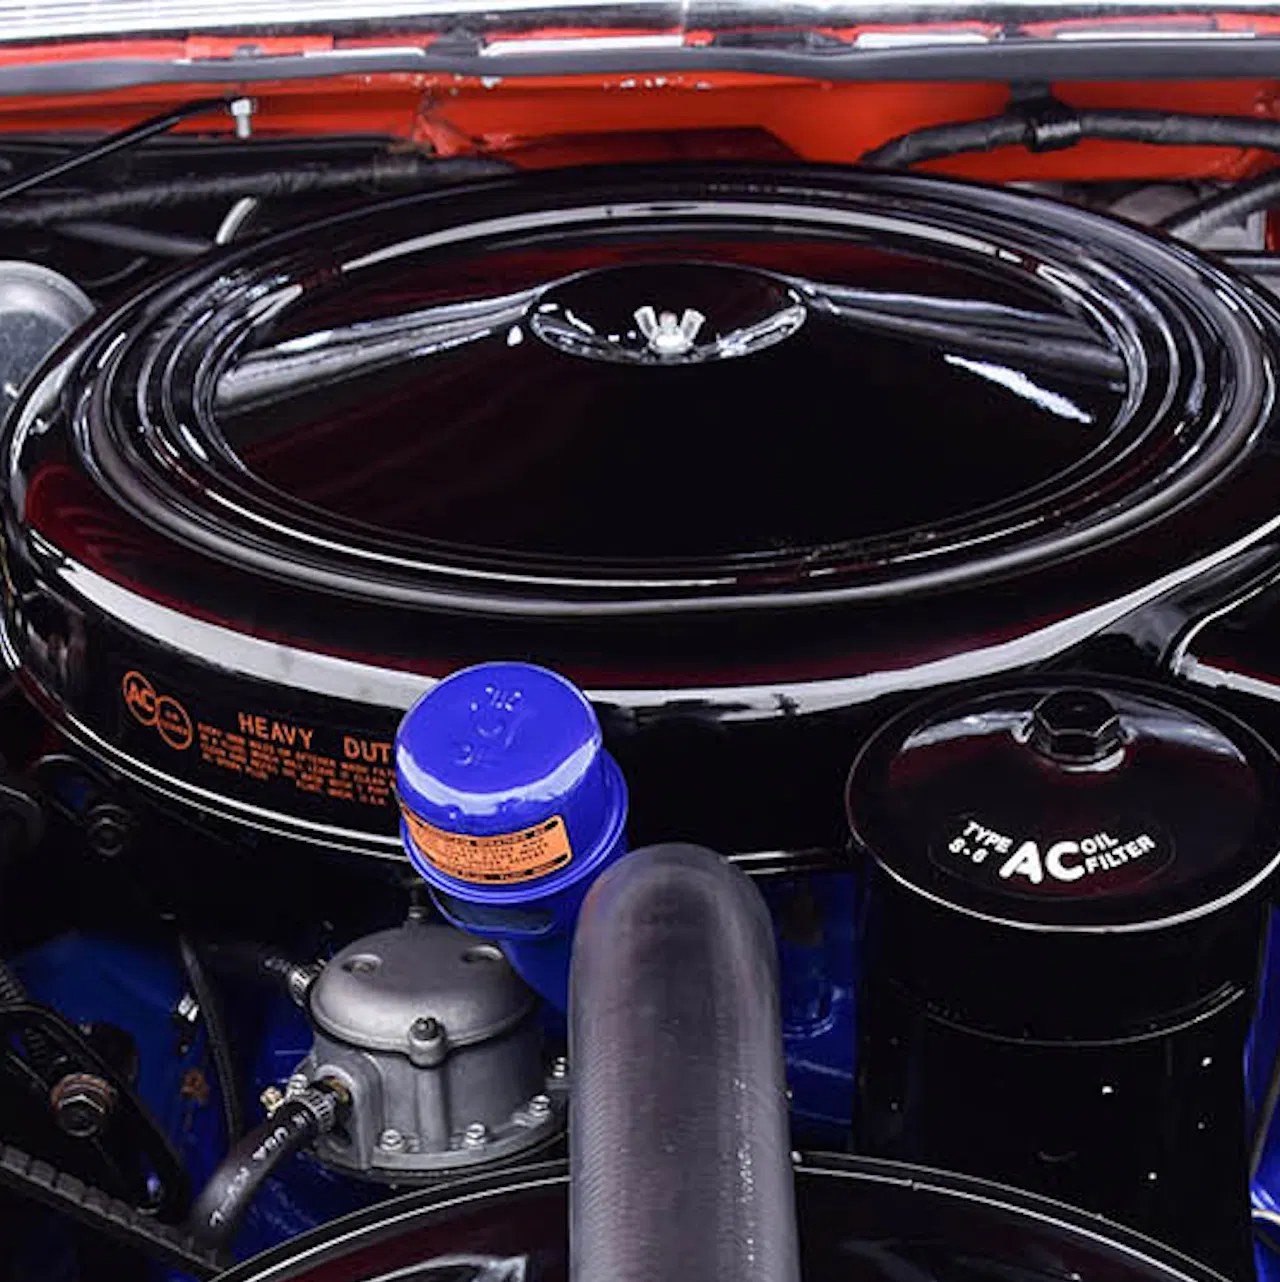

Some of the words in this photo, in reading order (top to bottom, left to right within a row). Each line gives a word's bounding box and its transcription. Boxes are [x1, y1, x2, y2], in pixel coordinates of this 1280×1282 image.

[237, 711, 314, 750] HEAVY
[343, 735, 392, 764] DUT
[963, 820, 1013, 853] TYPE
[1080, 831, 1119, 855] OIL
[1084, 834, 1156, 874] FILTER
[998, 840, 1086, 884] AC
